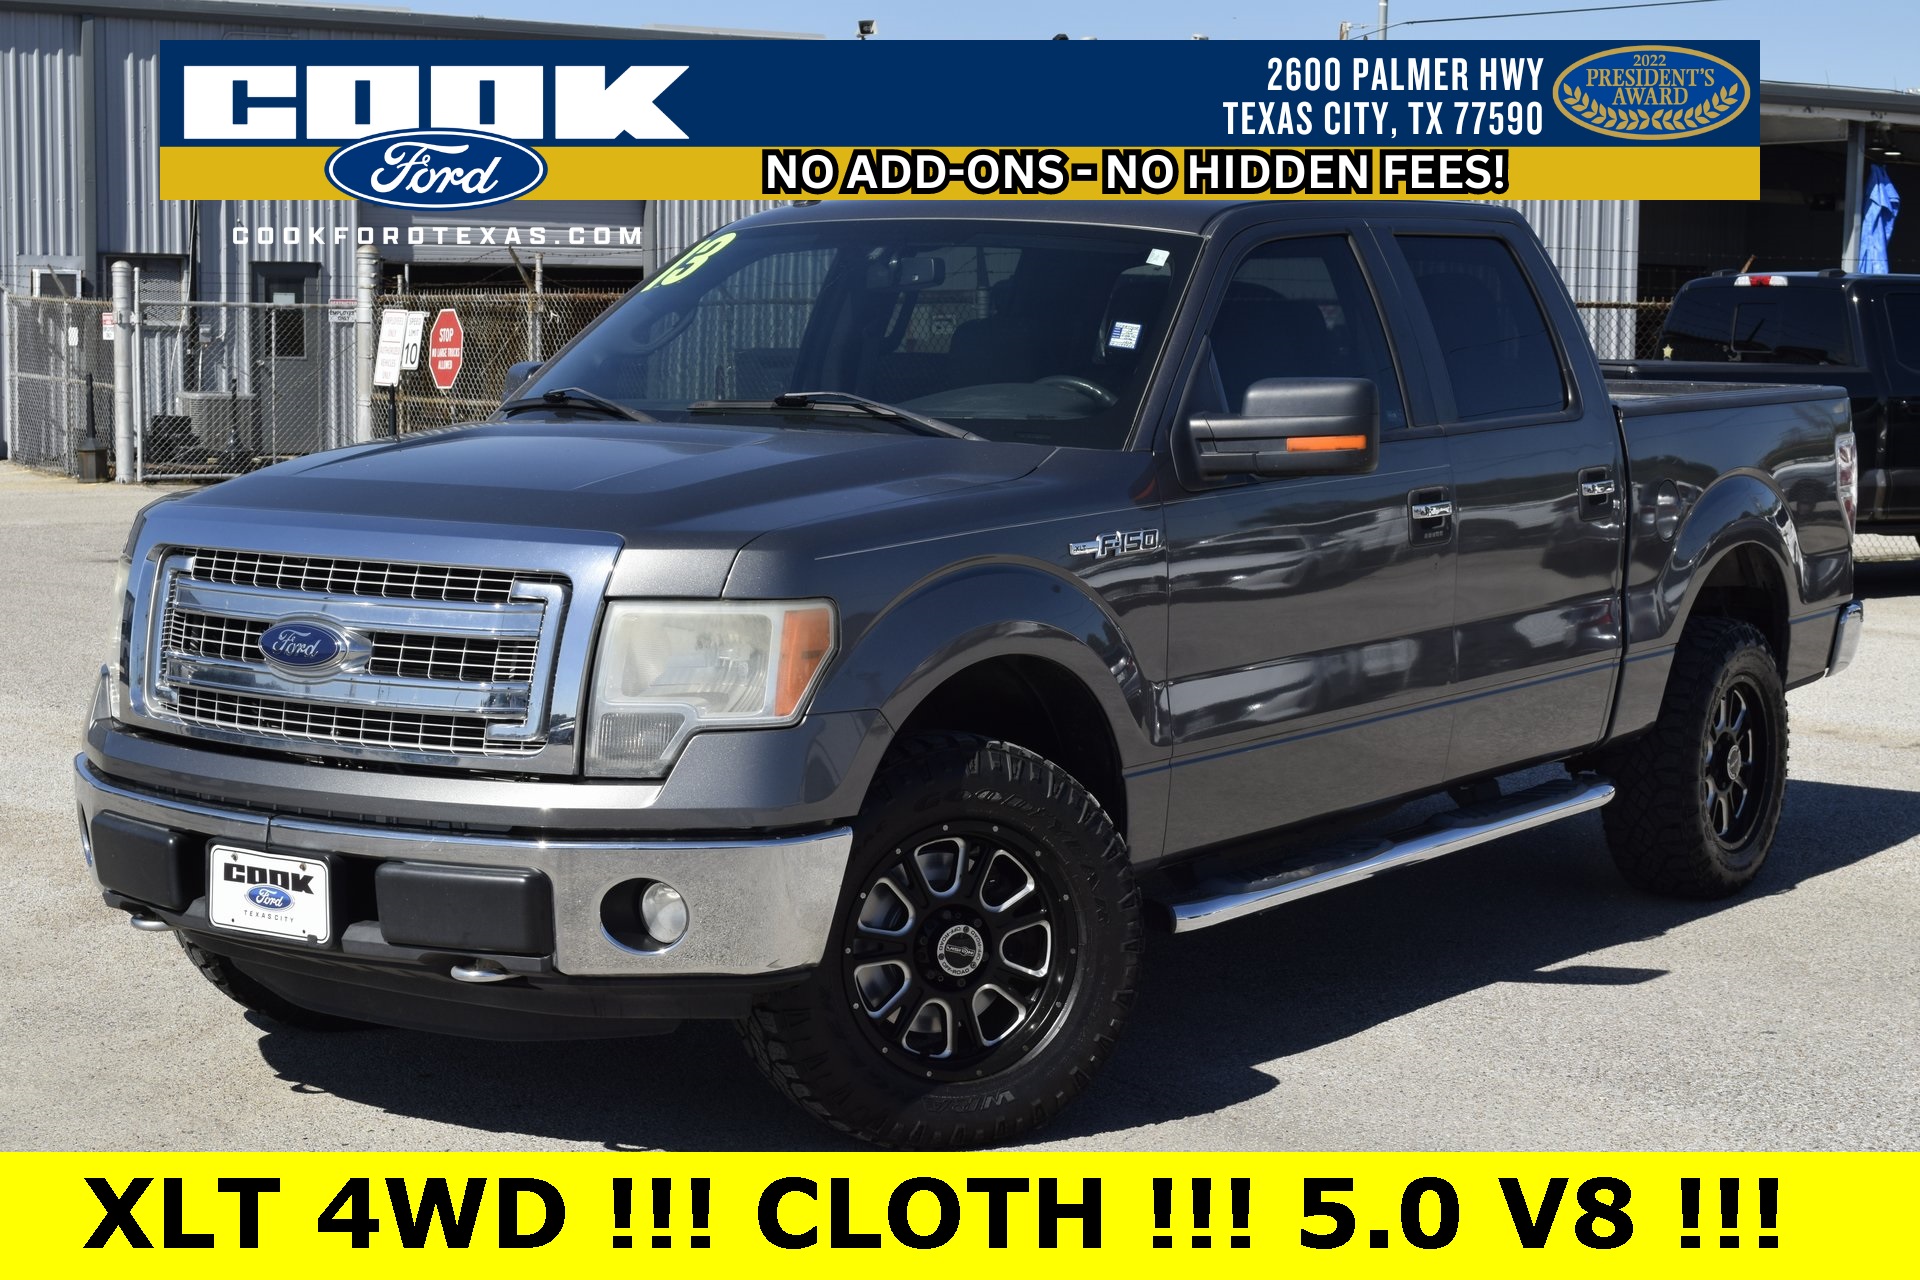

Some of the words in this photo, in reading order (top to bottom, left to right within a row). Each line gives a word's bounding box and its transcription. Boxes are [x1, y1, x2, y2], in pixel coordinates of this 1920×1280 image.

[439, 328, 454, 342] STOP
[404, 342, 418, 365] 10
[1096, 529, 1159, 559] F-150
[273, 629, 321, 657] Ford
[223, 862, 314, 894] COOK
[255, 888, 283, 907] Ford
